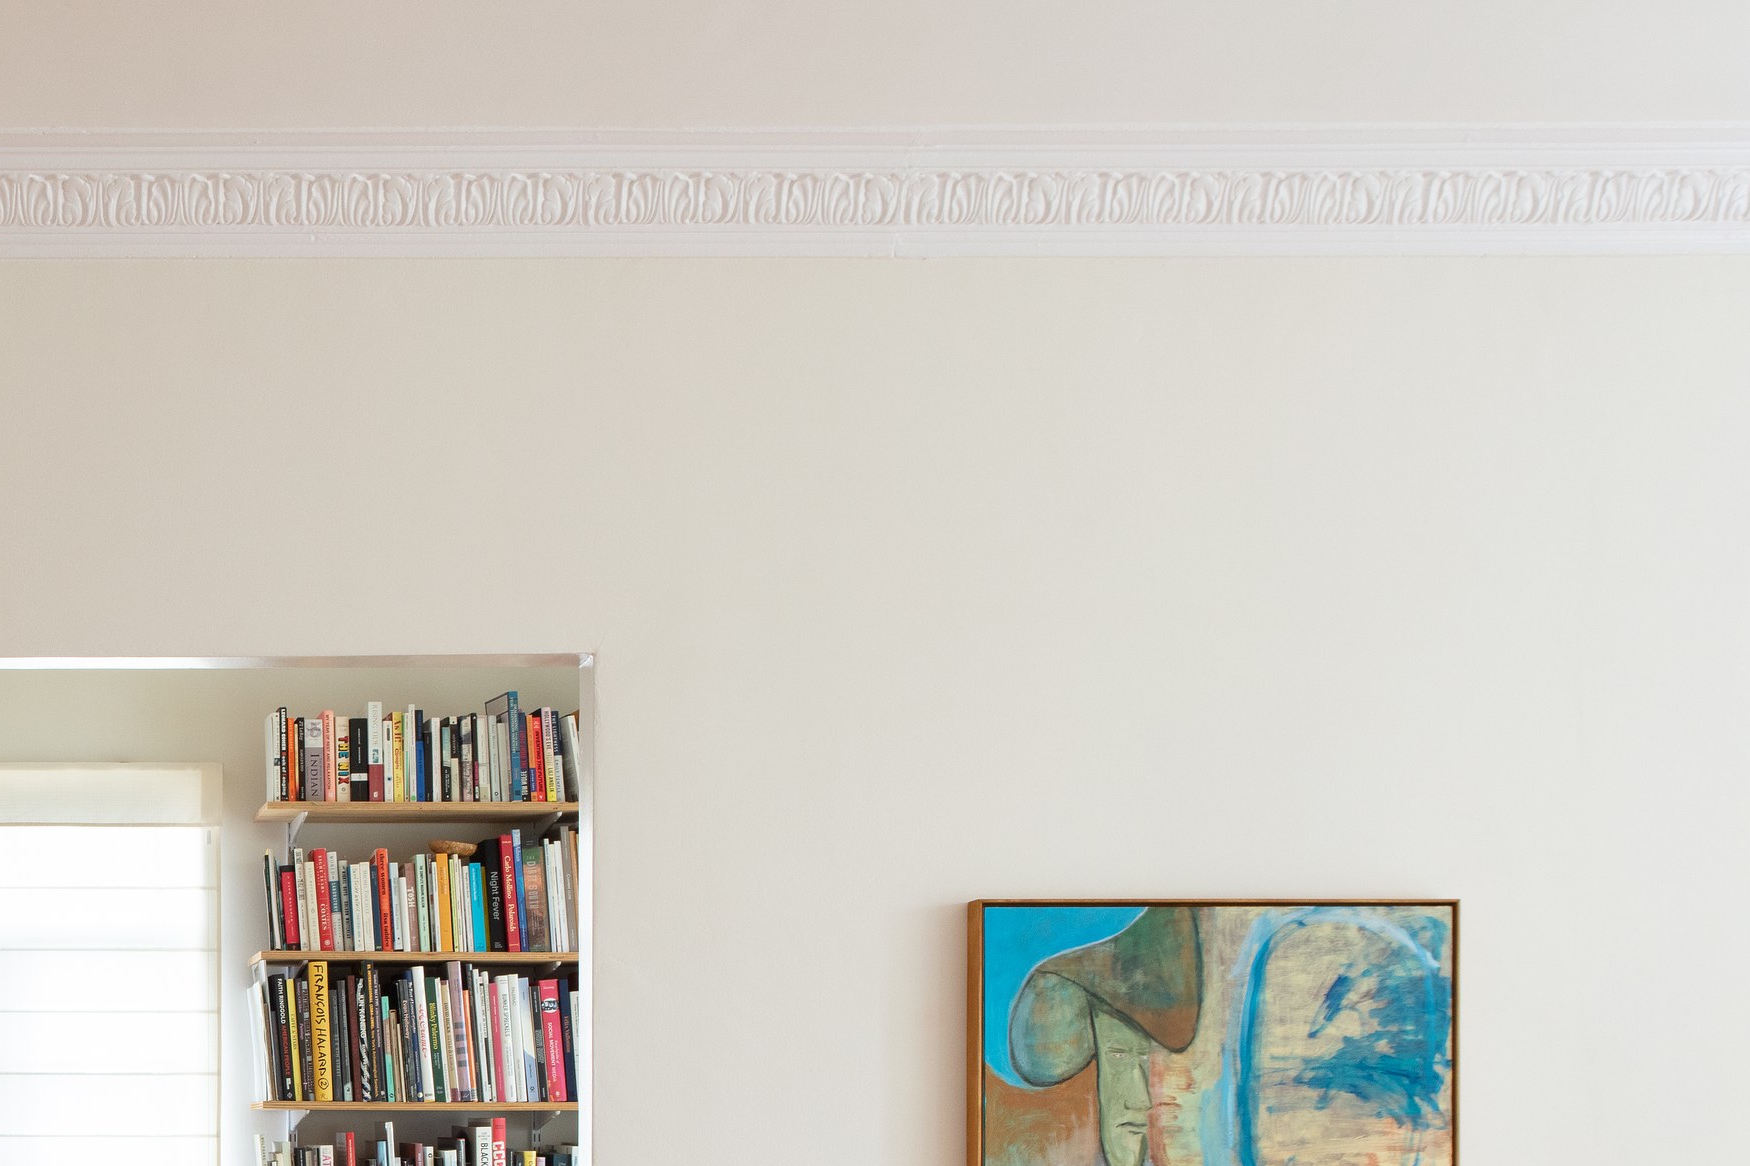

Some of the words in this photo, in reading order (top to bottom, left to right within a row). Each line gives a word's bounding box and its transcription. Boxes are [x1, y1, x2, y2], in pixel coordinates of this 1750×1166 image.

[338, 736, 349, 758] THE
[310, 754, 320, 797] INDIAN
[338, 762, 350, 785] NIX
[527, 861, 537, 881] DIRTY
[490, 872, 498, 895] Night
[505, 874, 513, 899] Mollino
[407, 887, 415, 908] TOSH
[528, 885, 539, 909] SOUTH
[508, 904, 517, 932] Polaroids
[314, 965, 327, 1024] FRANÇOIS
[315, 1027, 327, 1077] HALARD
[480, 1142, 489, 1166] BLACK
